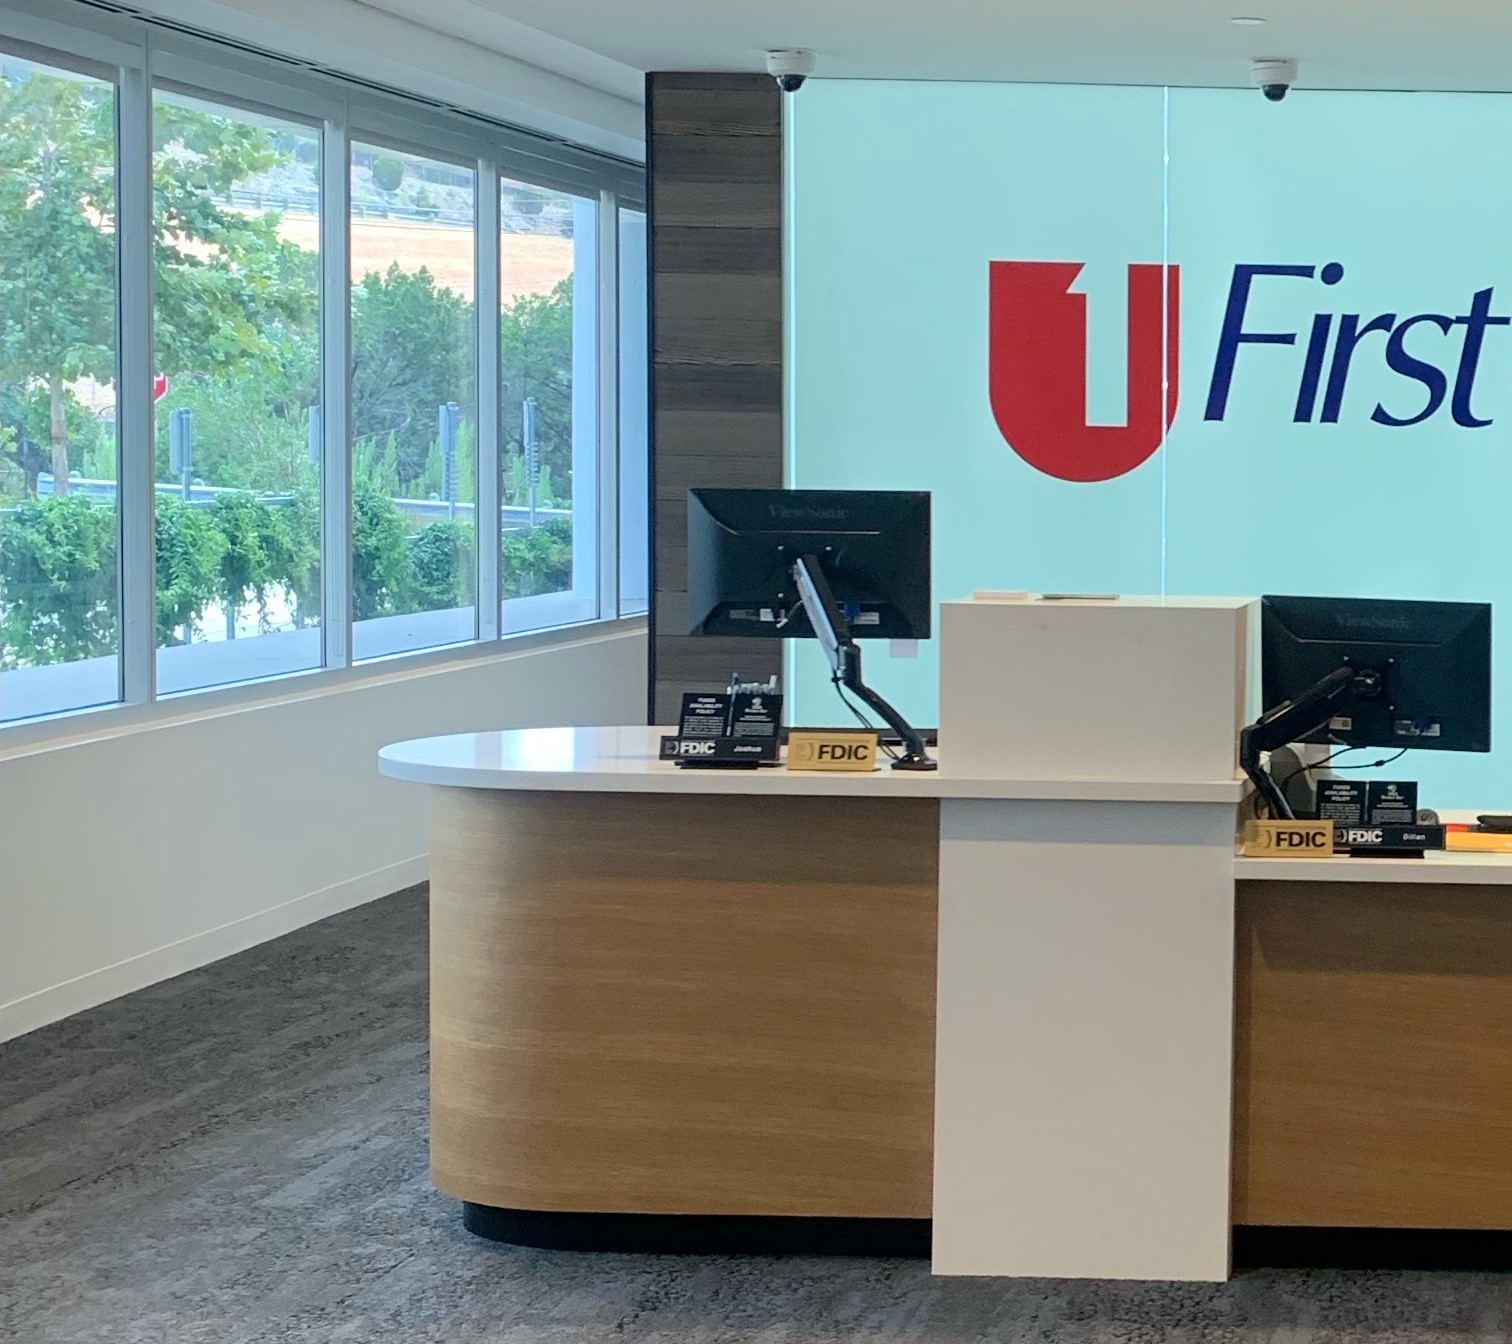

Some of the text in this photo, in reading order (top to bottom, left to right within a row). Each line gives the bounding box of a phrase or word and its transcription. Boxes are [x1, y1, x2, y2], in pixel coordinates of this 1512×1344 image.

[680, 741, 716, 755] FDIC
[817, 744, 869, 761] FDIC
[1275, 830, 1326, 847] FDIC
[1348, 830, 1383, 844] FDIC
